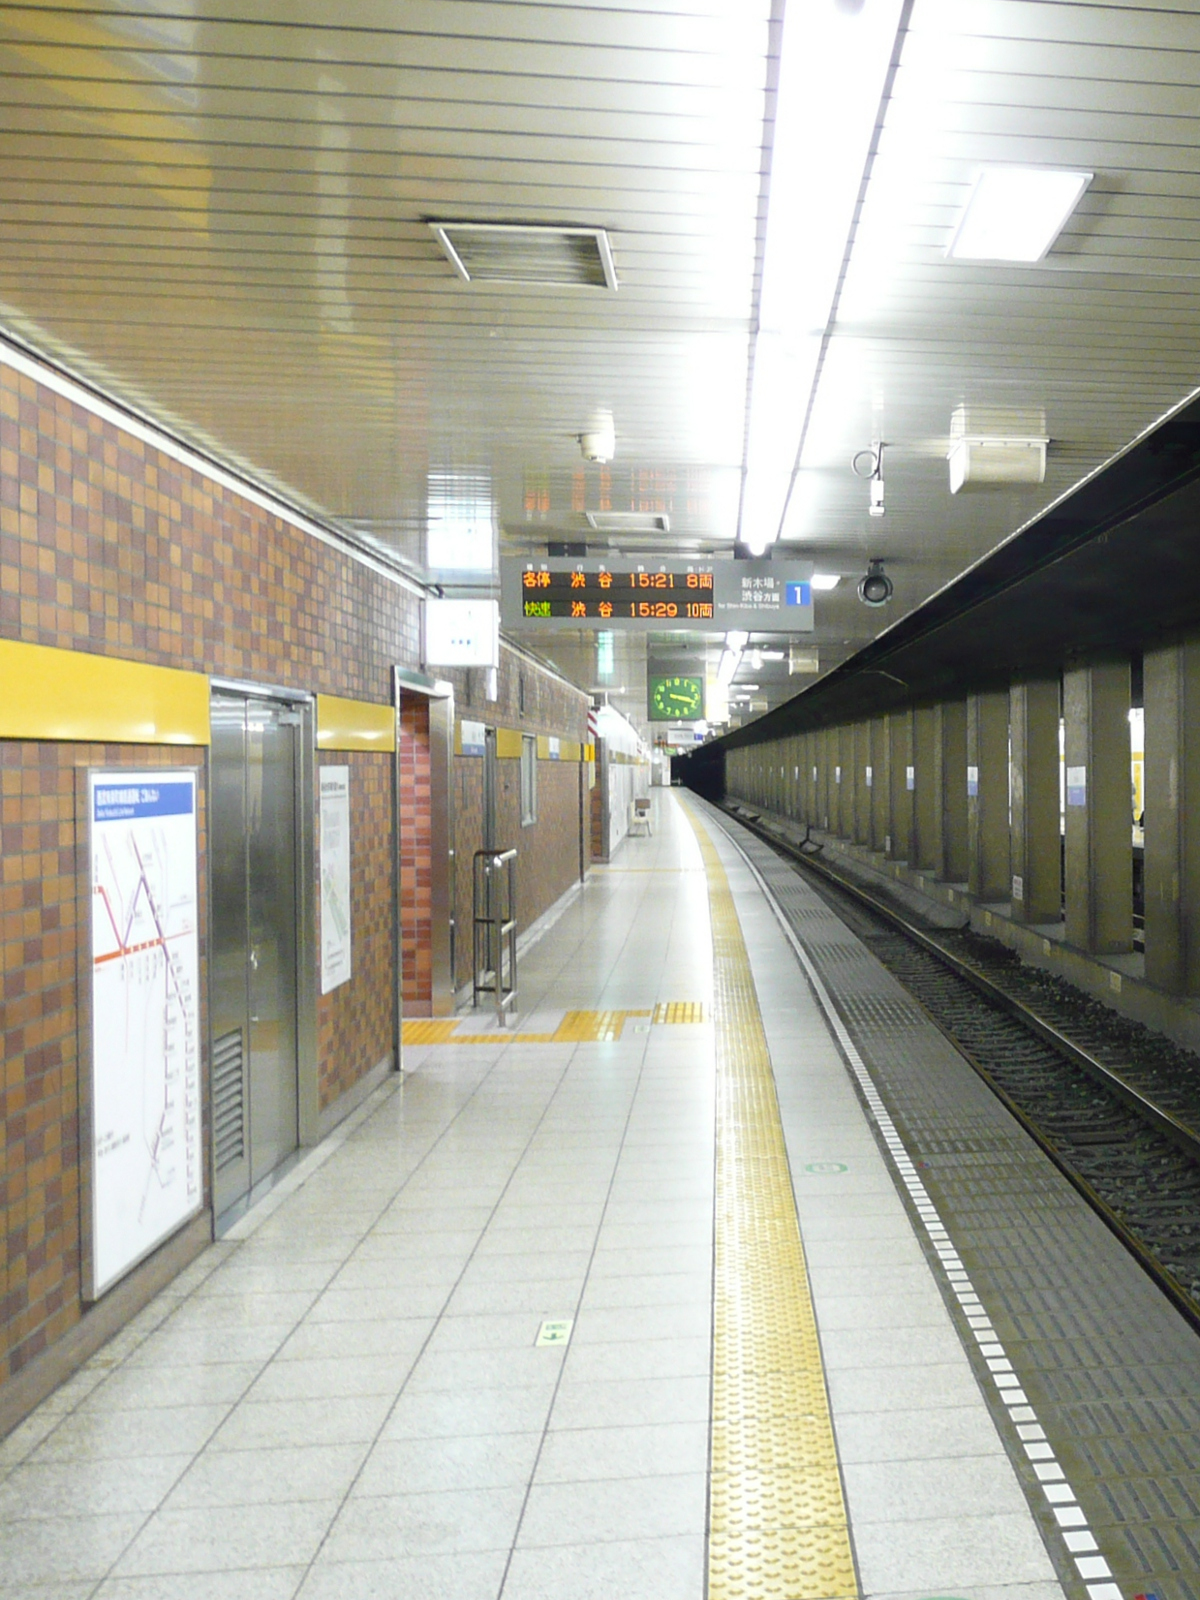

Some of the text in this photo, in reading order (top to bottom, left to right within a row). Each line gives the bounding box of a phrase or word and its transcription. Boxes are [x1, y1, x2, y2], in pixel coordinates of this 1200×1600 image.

[523, 572, 551, 587] 各停
[630, 573, 674, 588] 15:21
[686, 573, 713, 589] 8両
[742, 590, 780, 602] 渋谷方面
[794, 586, 802, 605] 1
[524, 601, 551, 617] 快速
[630, 602, 678, 618] 15:29
[686, 602, 713, 618] 10両
